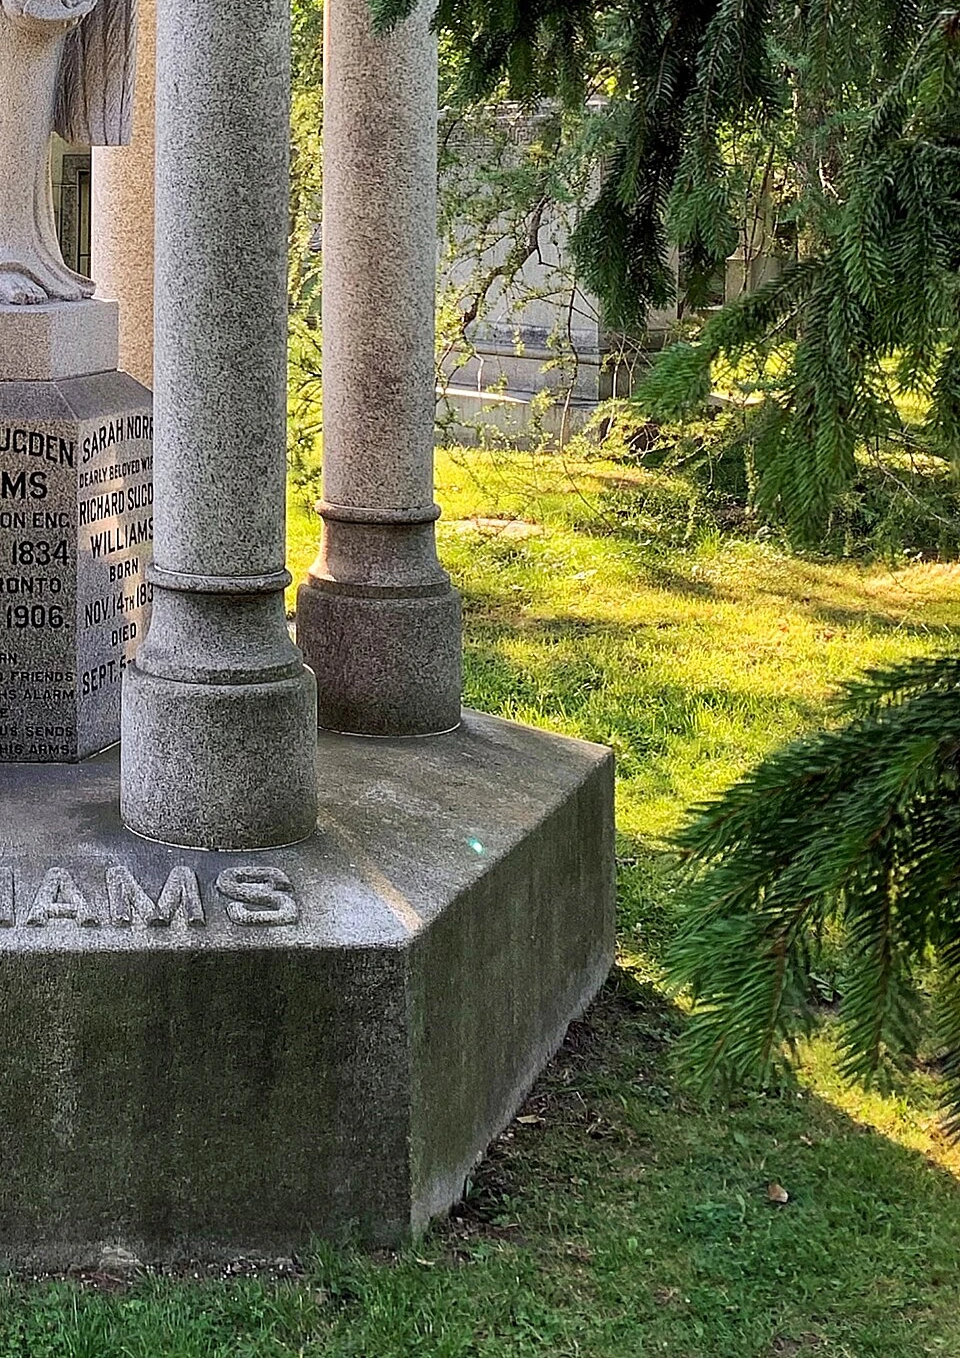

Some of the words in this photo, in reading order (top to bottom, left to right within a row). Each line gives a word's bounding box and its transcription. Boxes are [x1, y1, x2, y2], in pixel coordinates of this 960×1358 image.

[82, 418, 124, 463] SARAH
[127, 415, 153, 441] NORR
[79, 465, 108, 489] DEARLY
[109, 459, 140, 480] BELOVED
[79, 490, 125, 527] RICHARD
[127, 482, 153, 511] SUGD
[90, 516, 153, 559] WILLIAMS
[12, 540, 70, 566] 1834
[109, 558, 139, 583] BORN
[6, 605, 70, 629] 1906.
[84, 597, 111, 629] NOV.
[136, 581, 153, 608] 183
[111, 622, 137, 647] DIED
[10, 671, 74, 683] FRIENDS
[82, 660, 118, 695] SEPT.
[23, 689, 74, 701] ALARM
[25, 726, 74, 738] SENDS
[0, 744, 23, 755] HIS
